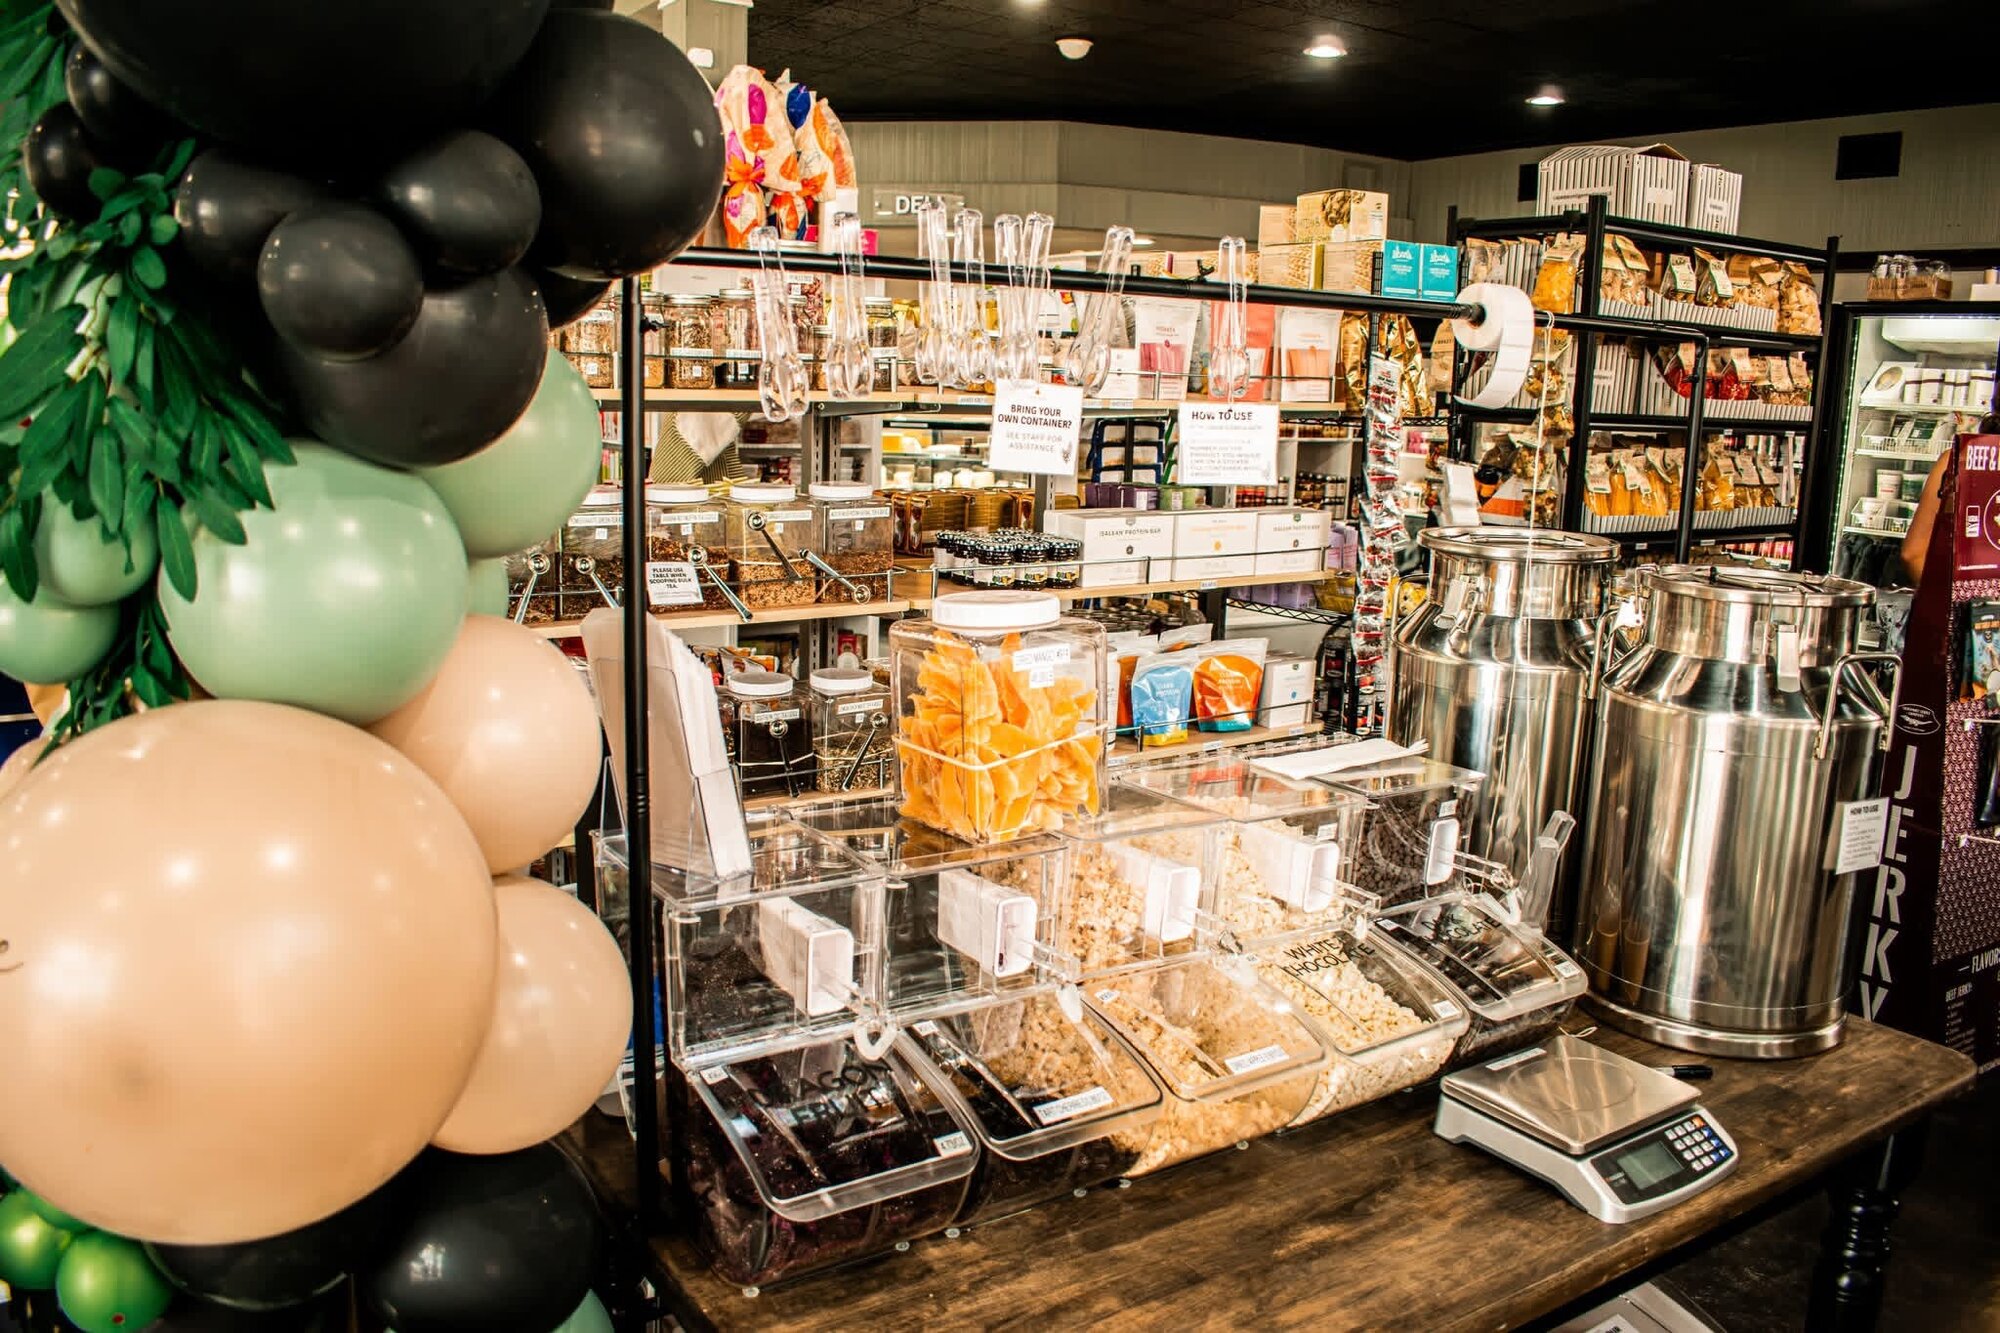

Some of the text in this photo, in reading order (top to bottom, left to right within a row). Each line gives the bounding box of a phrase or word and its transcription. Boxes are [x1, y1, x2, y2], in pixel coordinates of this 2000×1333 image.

[1010, 404, 1062, 417] BRING YOUR
[1218, 411, 1232, 421] TO
[1234, 411, 1253, 421] USE
[997, 413, 1072, 429] OWN CONTAINER?
[1965, 444, 1996, 471] BEEF &
[1850, 807, 1862, 815] HOW
[1870, 804, 1879, 813] USE
[1859, 744, 1917, 1023] JERKY
[1283, 938, 1340, 960] WHITE
[747, 1059, 892, 1106] DAGON
